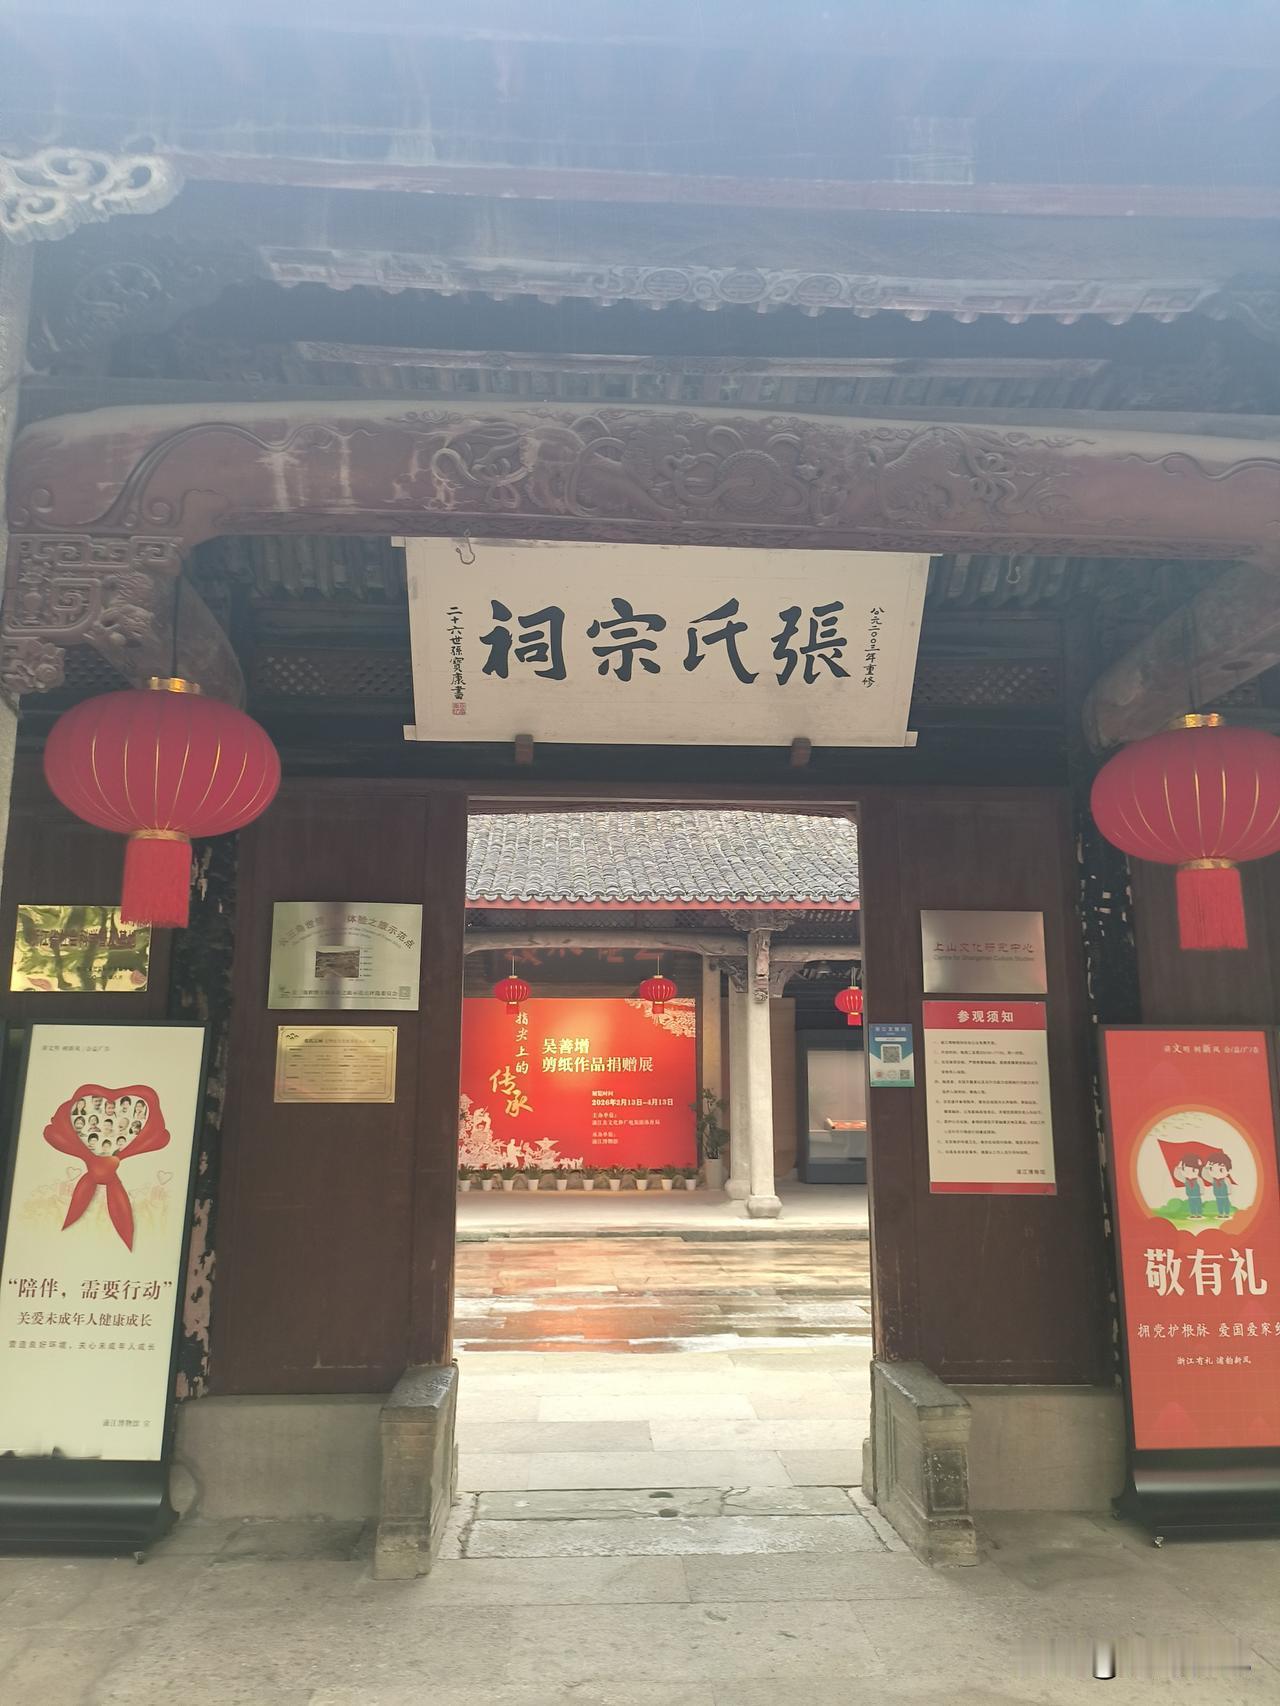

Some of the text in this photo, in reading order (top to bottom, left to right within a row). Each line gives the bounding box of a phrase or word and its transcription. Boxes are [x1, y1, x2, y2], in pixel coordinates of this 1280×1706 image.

[933, 943, 1035, 953] 上山文化研究中心
[956, 1009, 1015, 1023] 参观须知
[515, 1011, 529, 1075] 指尖上的
[541, 1038, 590, 1055] 吴善增
[541, 1056, 654, 1073] 剪纸作品捐赠展
[489, 1065, 534, 1118] 传承
[1143, 1247, 1268, 1296] 敬有礼
[17, 1311, 153, 1327] 关爱未成年人健康成长
[1137, 1322, 1211, 1338] 拥党护根脉
